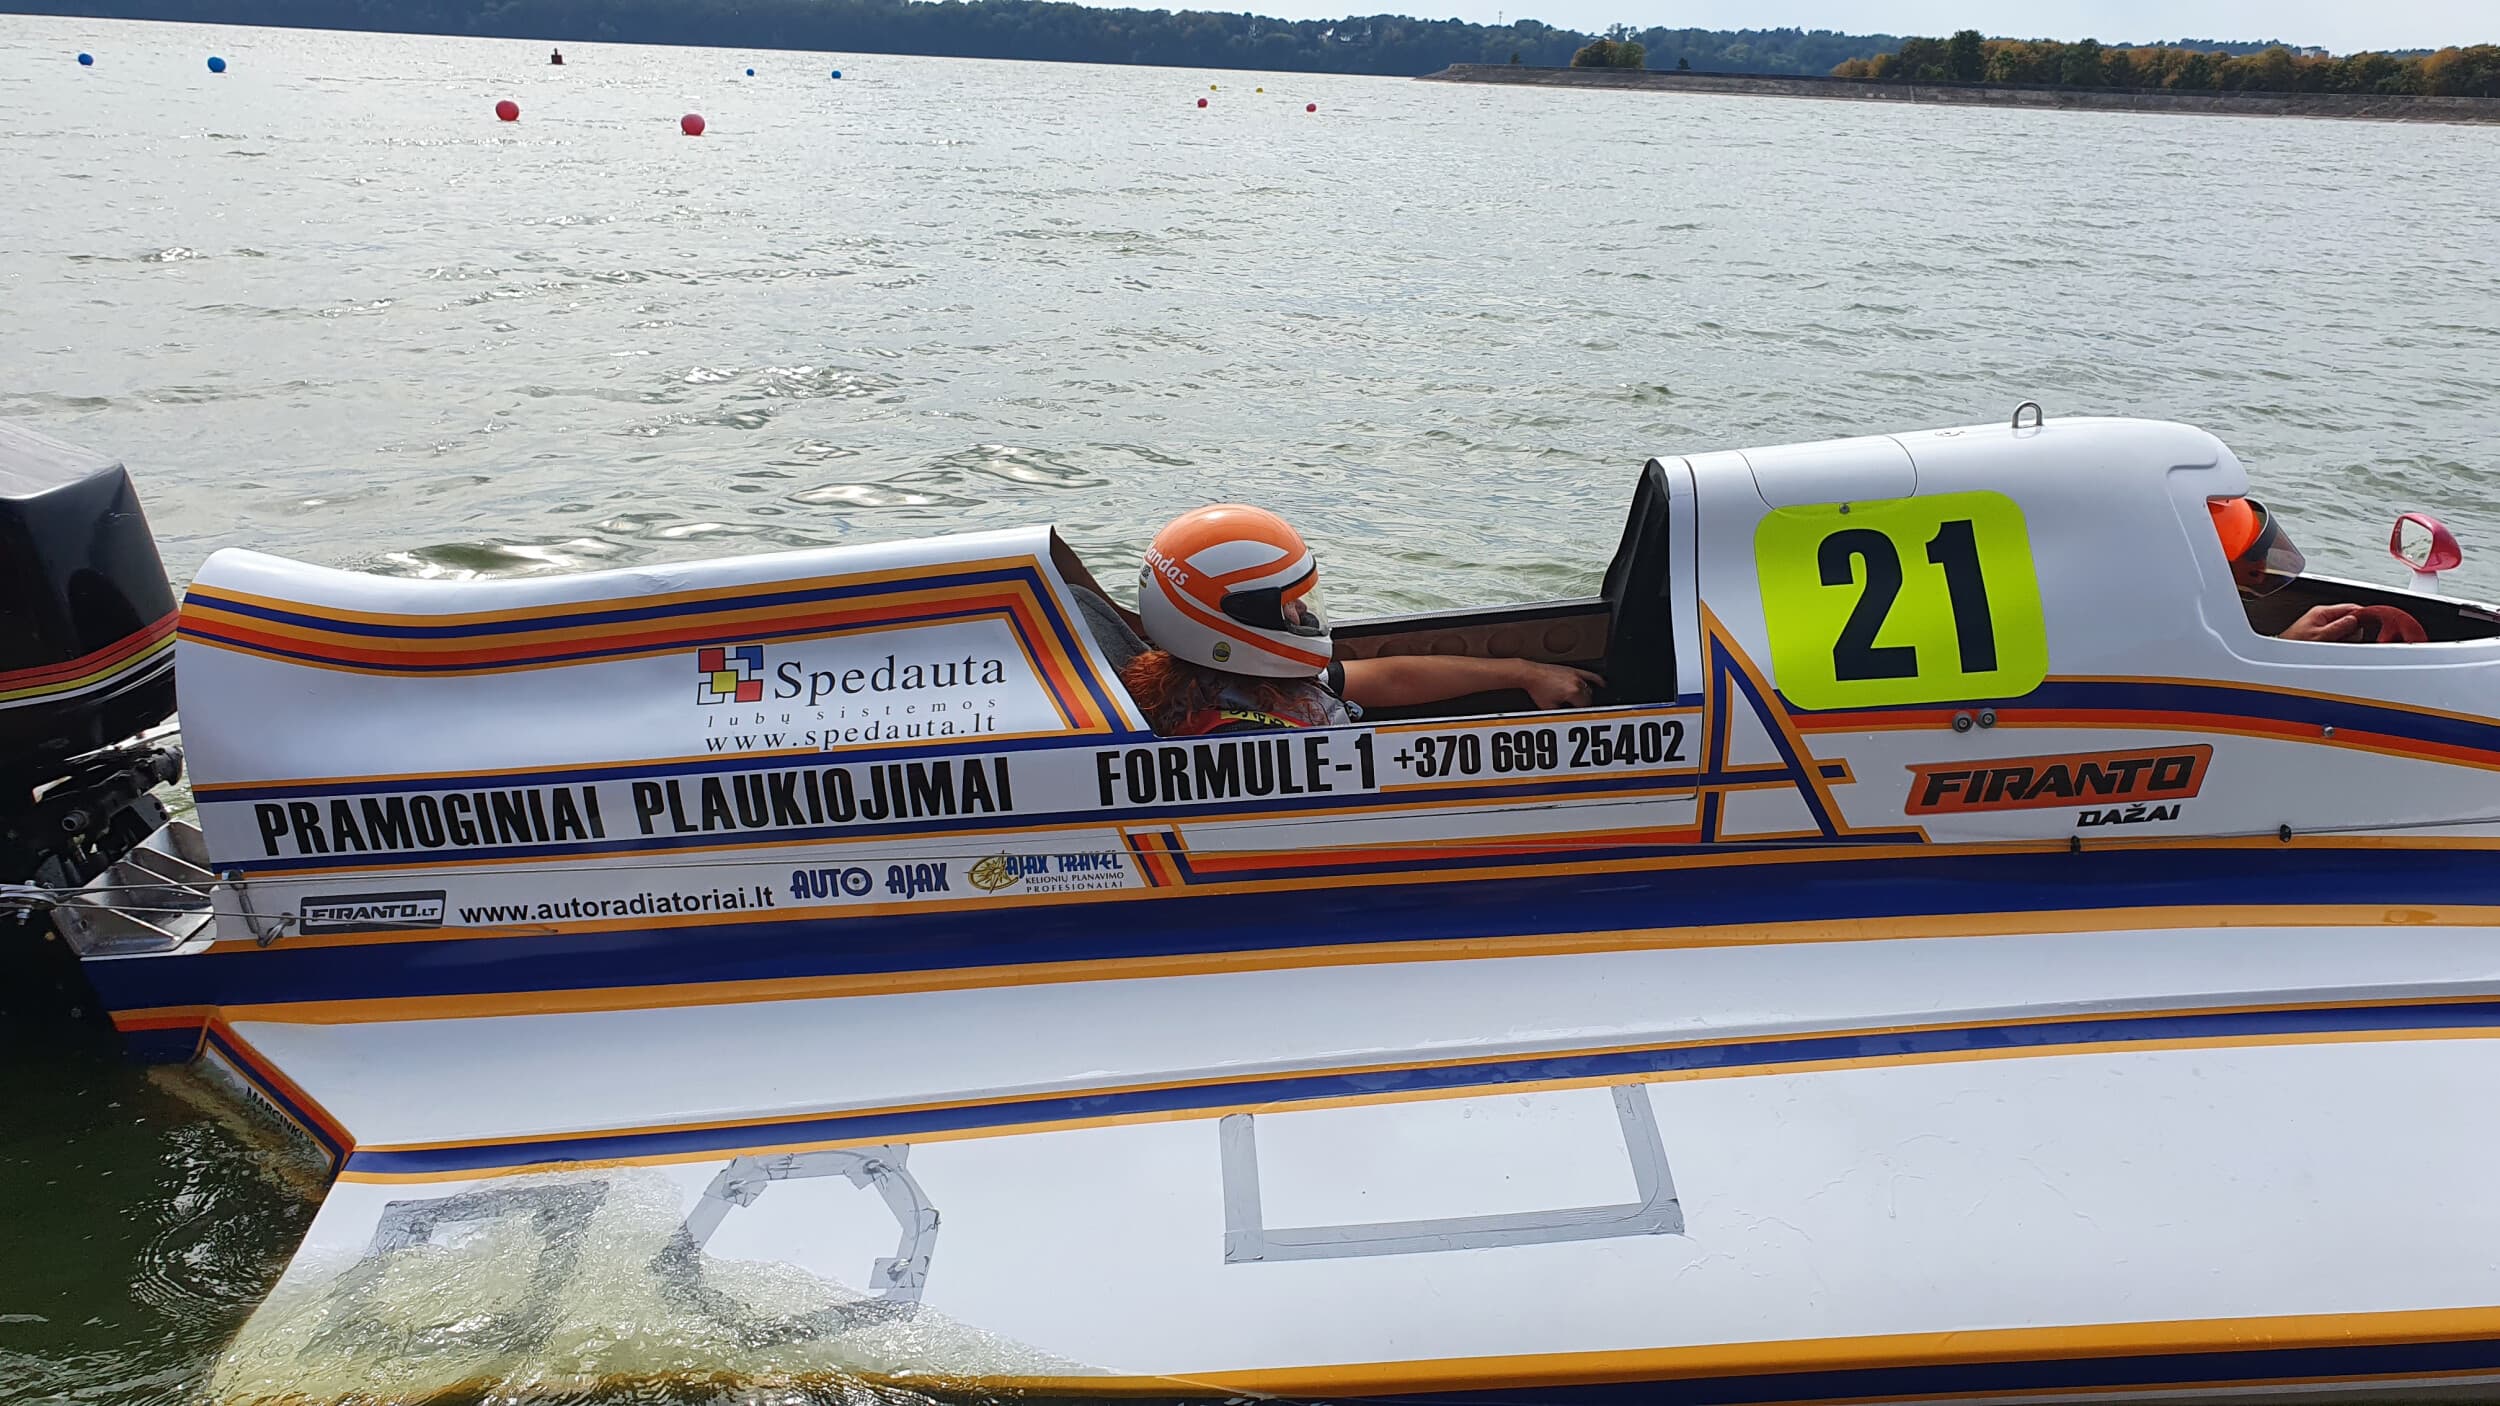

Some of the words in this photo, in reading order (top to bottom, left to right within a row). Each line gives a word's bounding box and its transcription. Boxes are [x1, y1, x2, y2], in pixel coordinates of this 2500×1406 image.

[1817, 519, 1998, 682] 21
[774, 655, 1007, 707] Spedauta
[708, 712, 791, 728] lubų
[816, 698, 997, 721] sistemos
[705, 712, 997, 752] www.spedauta.lt
[1096, 732, 1376, 806] FORMULE-1
[1393, 734, 1481, 777] +370
[1491, 728, 1558, 773] 699
[1567, 720, 1686, 768] 25402
[1920, 755, 2197, 806] FIRANTO
[255, 785, 606, 856] PRAMOGINIAI
[632, 758, 1013, 835] PLAUKIOJIMAI
[2077, 804, 2181, 828] DAŽAI
[790, 866, 873, 899] AUTO
[885, 862, 950, 899] AJAX
[1005, 854, 1050, 879] AJAX
[1054, 850, 1123, 873] TRAVEL
[1071, 871, 1124, 882] PLANAVIMO
[459, 887, 774, 924] www.autoradiatoriai.lt
[1026, 881, 1123, 893] PROFESIONALAI
